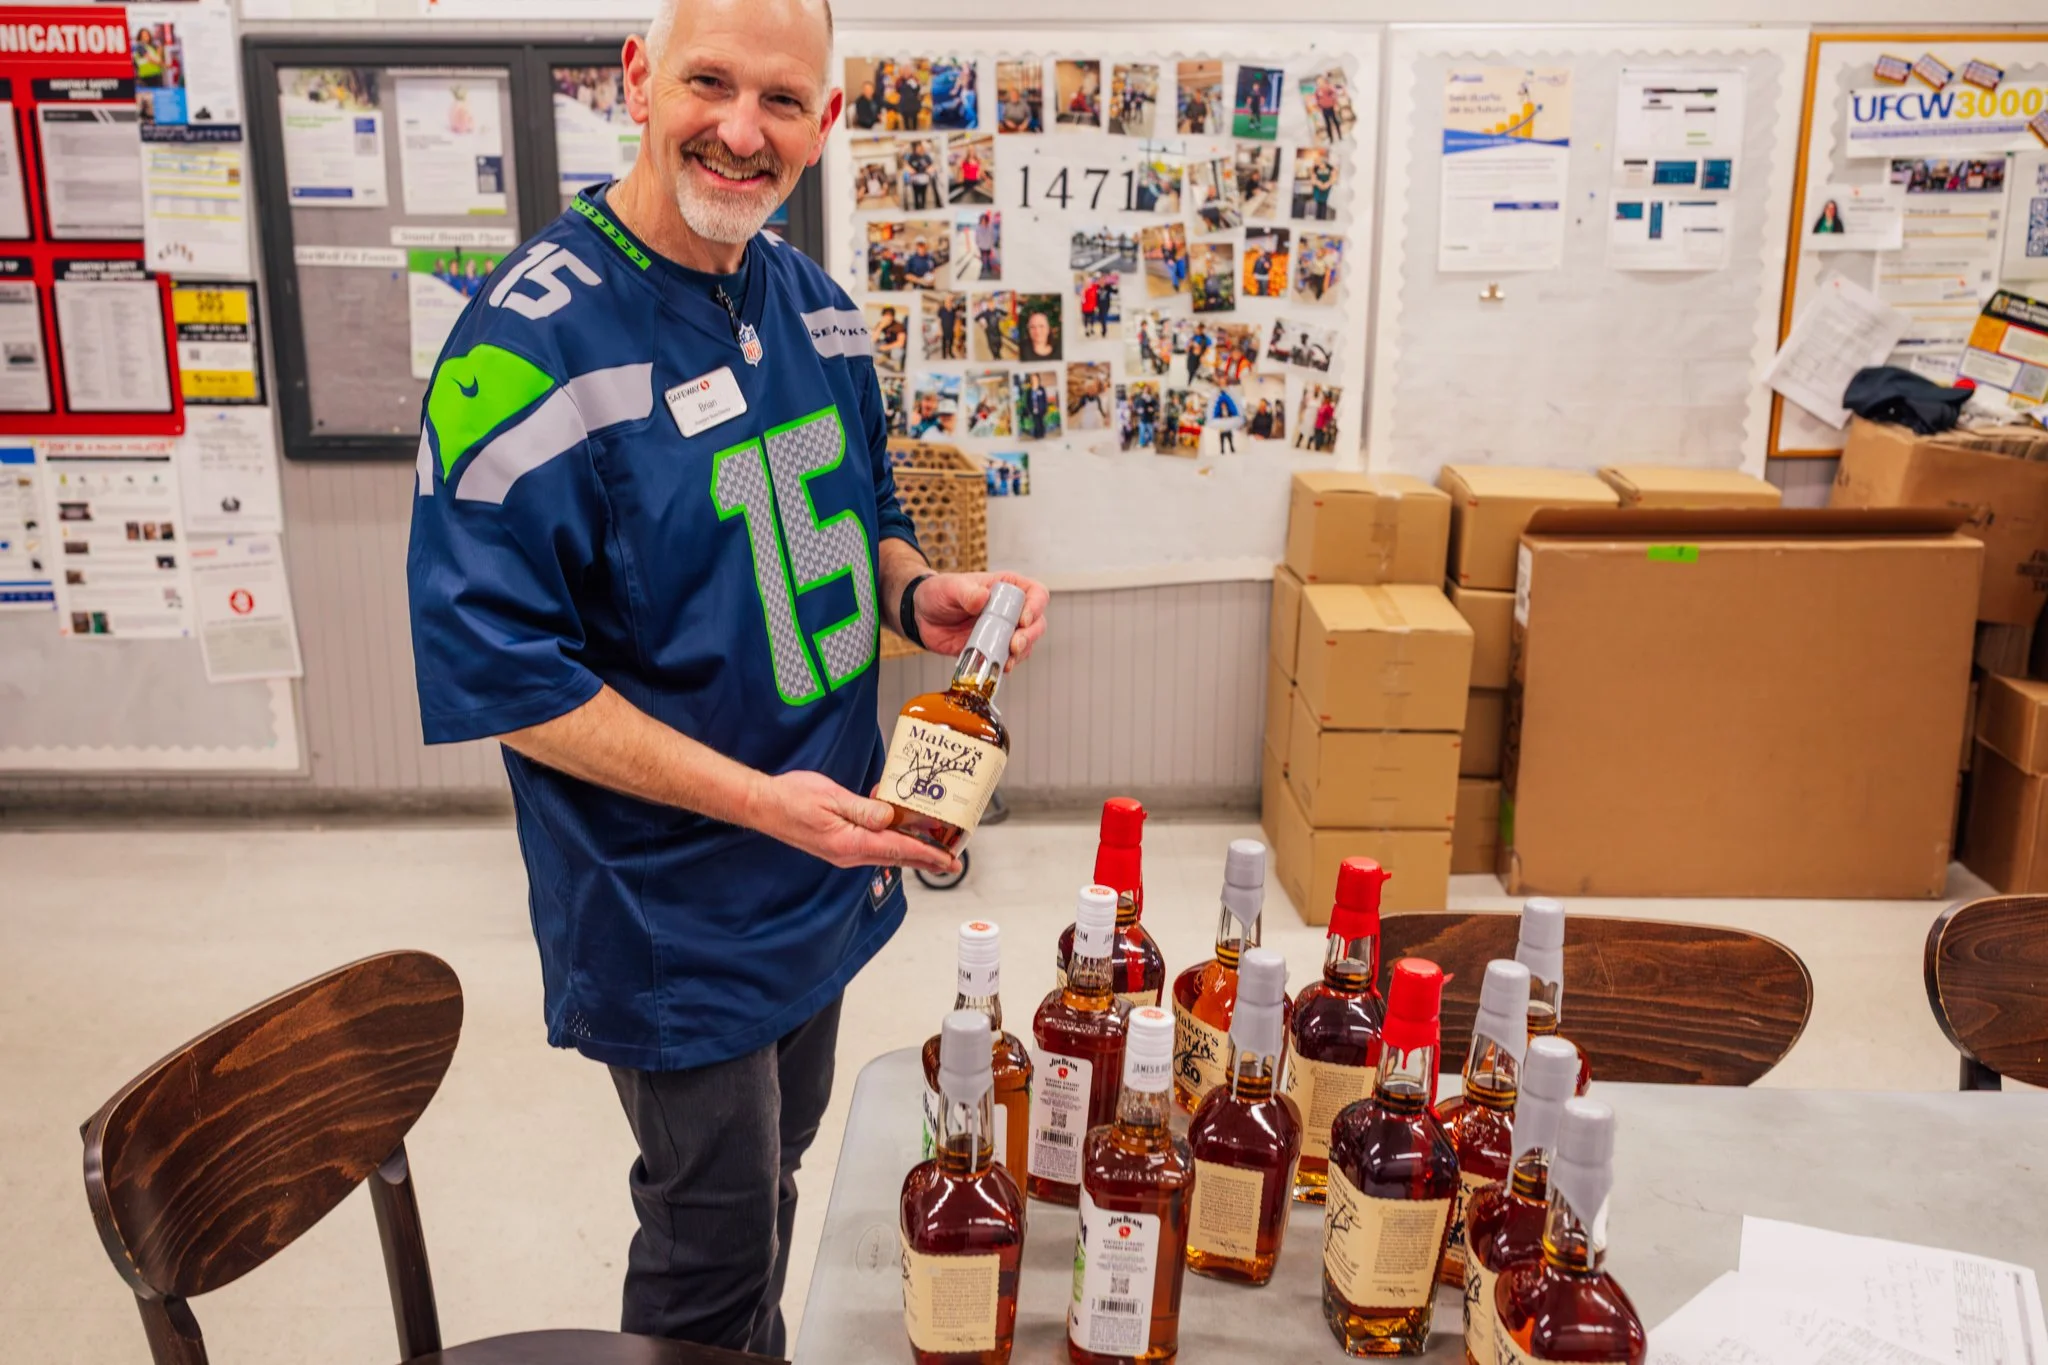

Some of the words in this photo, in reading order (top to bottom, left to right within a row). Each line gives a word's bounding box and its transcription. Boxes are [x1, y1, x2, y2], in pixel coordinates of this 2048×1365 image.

[0, 23, 126, 53] NICATION
[1018, 165, 1138, 211] 1471
[488, 241, 602, 320] 15
[668, 384, 700, 404] SAFEWAY
[698, 399, 718, 413] Brian
[710, 404, 879, 706] 15
[909, 725, 983, 761] Maker's
[922, 747, 977, 777] Mark
[1173, 1005, 1219, 1048] Maker's
[1049, 1057, 1061, 1068] JIM
[1061, 1057, 1078, 1072] BEAM
[1132, 1061, 1154, 1074] JAMES
[1108, 1216, 1122, 1228] JIM
[1123, 1215, 1142, 1230] BEAM
